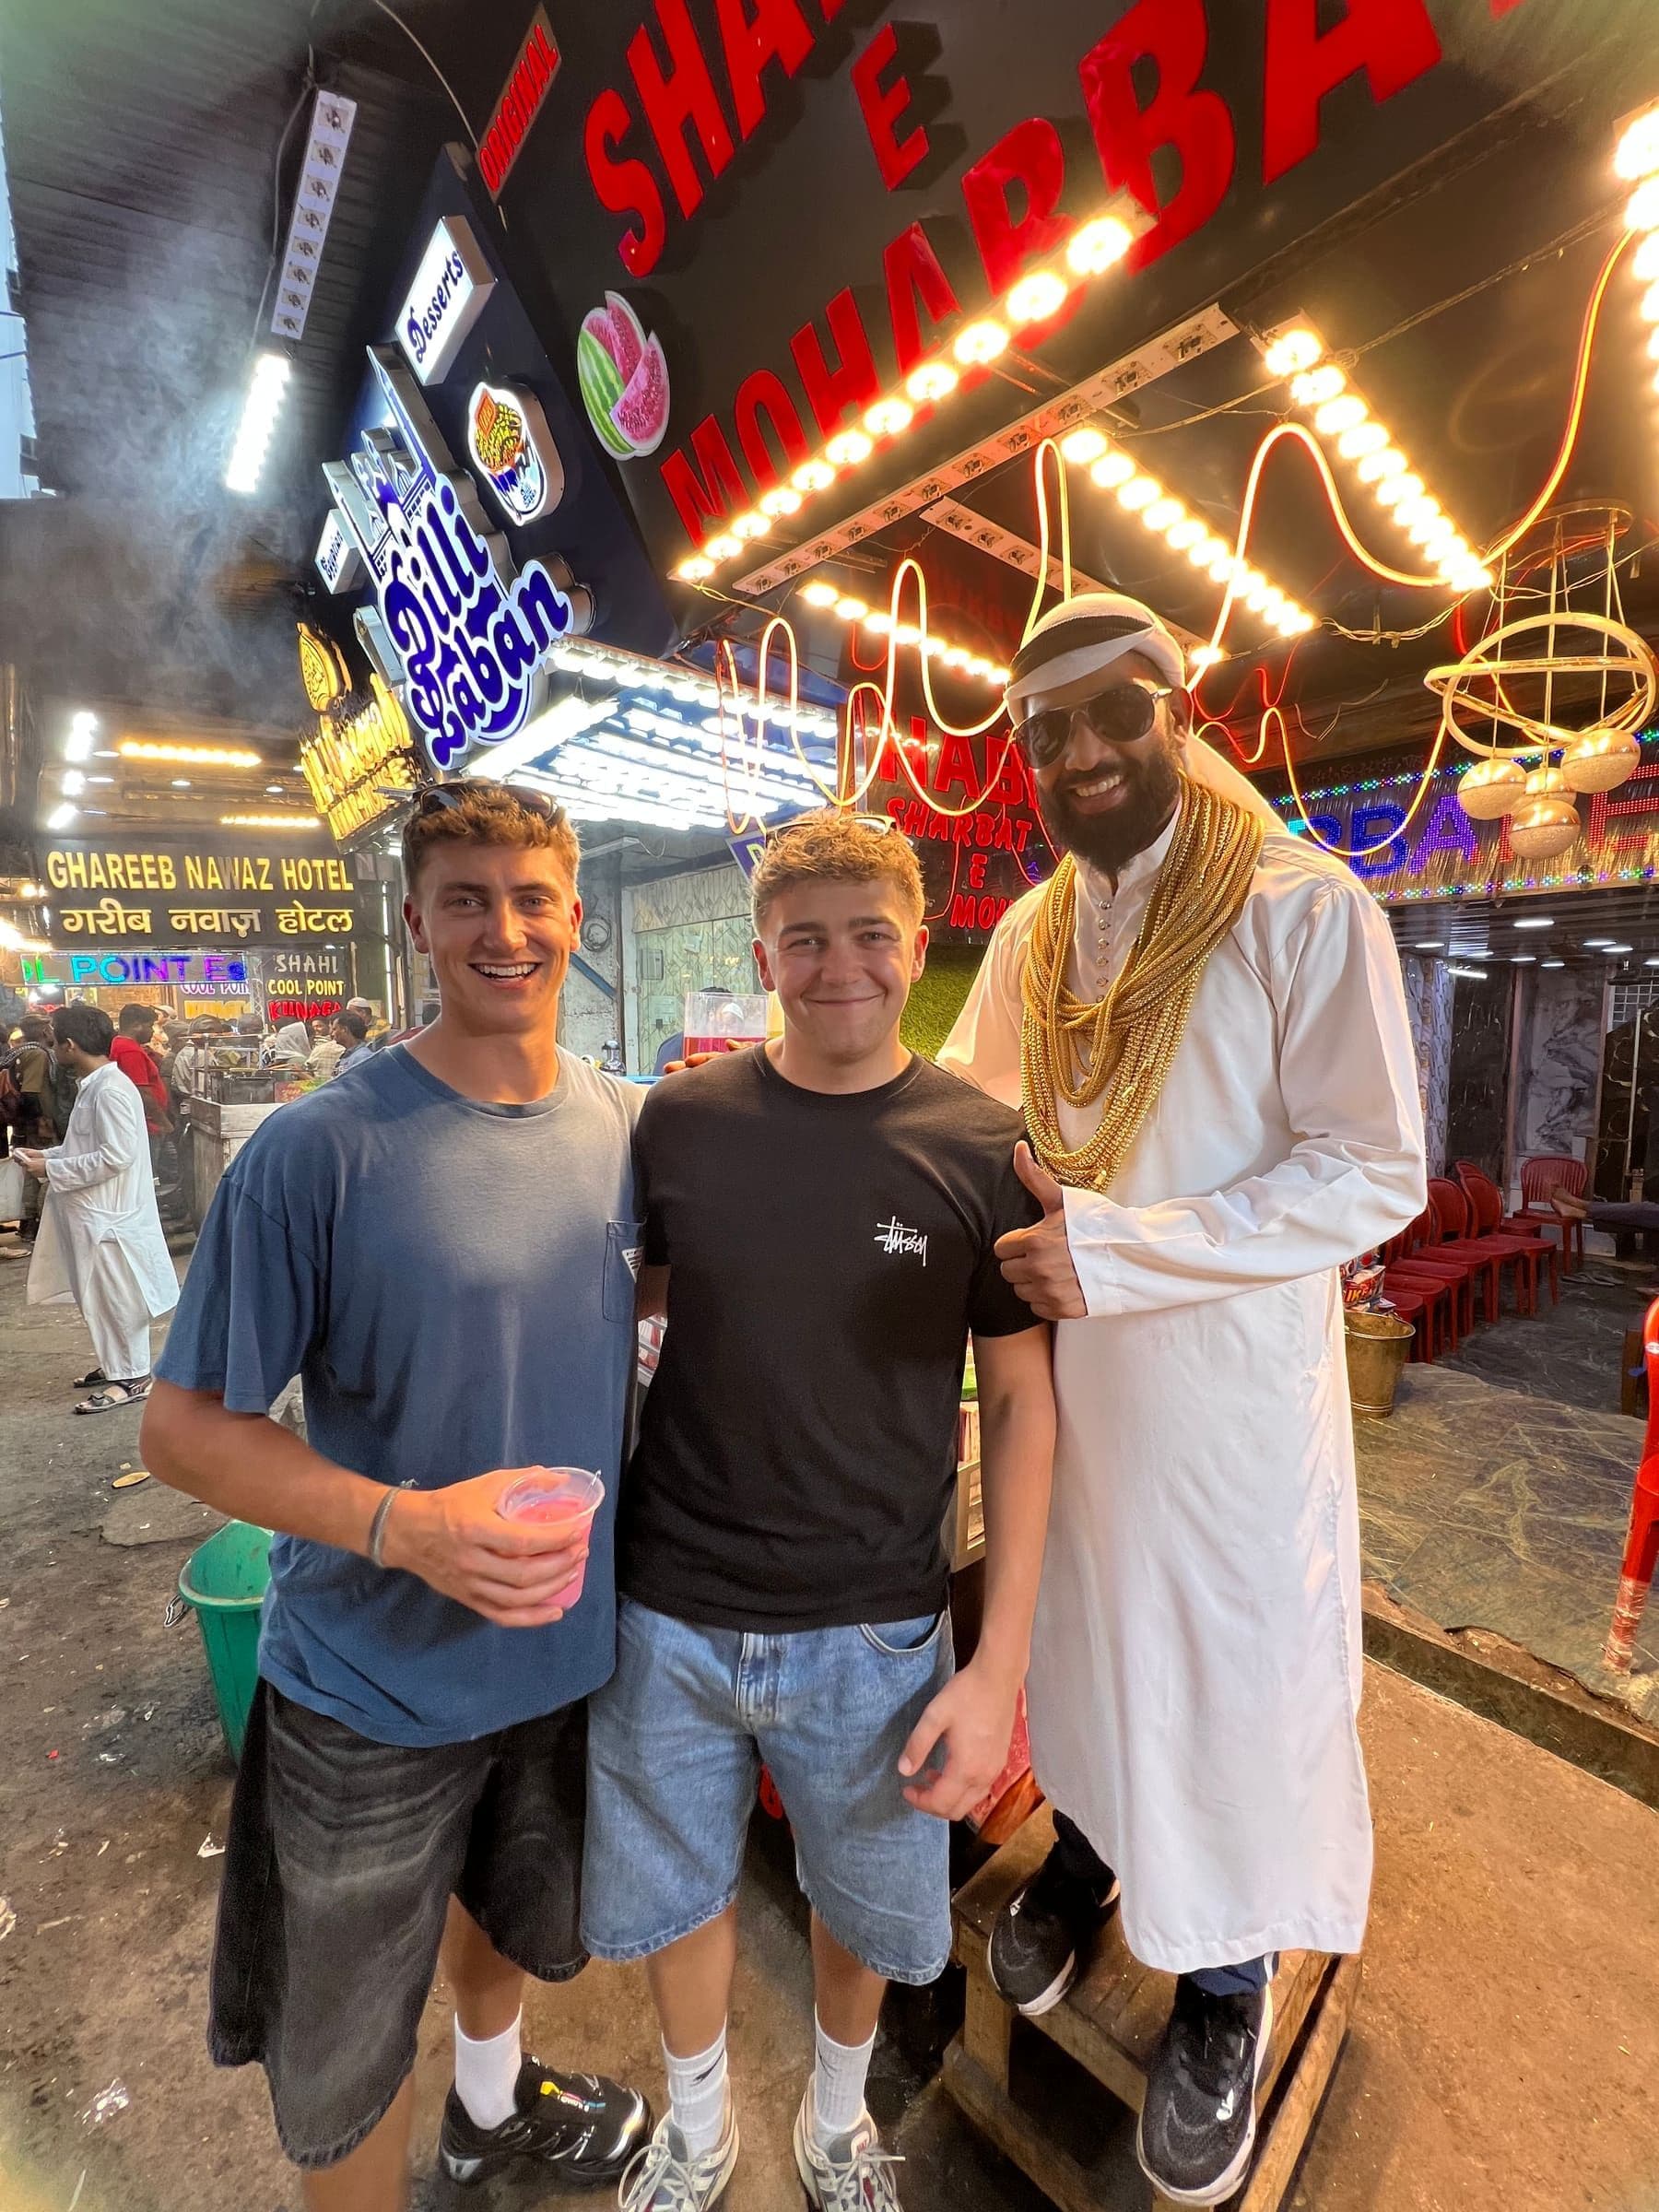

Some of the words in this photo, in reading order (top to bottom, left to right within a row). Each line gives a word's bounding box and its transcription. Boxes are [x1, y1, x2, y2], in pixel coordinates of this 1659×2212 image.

[479, 24, 558, 191] ORIGINAL
[584, 0, 846, 277] SHA
[850, 21, 930, 192] E
[406, 250, 464, 364] Desserts
[660, 0, 1519, 550] MOHABBA
[384, 485, 488, 673] Dilli
[408, 570, 569, 767] Laban
[887, 797, 1032, 853] SHARBAT
[1288, 794, 1514, 878] BA
[47, 851, 177, 890] GHAREEB
[184, 854, 274, 891] NAWAZ
[280, 858, 355, 892] HOTEL
[970, 853, 988, 888] E
[60, 897, 152, 935] गरीब
[168, 908, 261, 937] नवाज़
[275, 900, 354, 935] होटल
[71, 955, 192, 983] POINT
[267, 979, 303, 995] COOL
[306, 979, 345, 996] POINT
[275, 954, 338, 974] SHAHI
